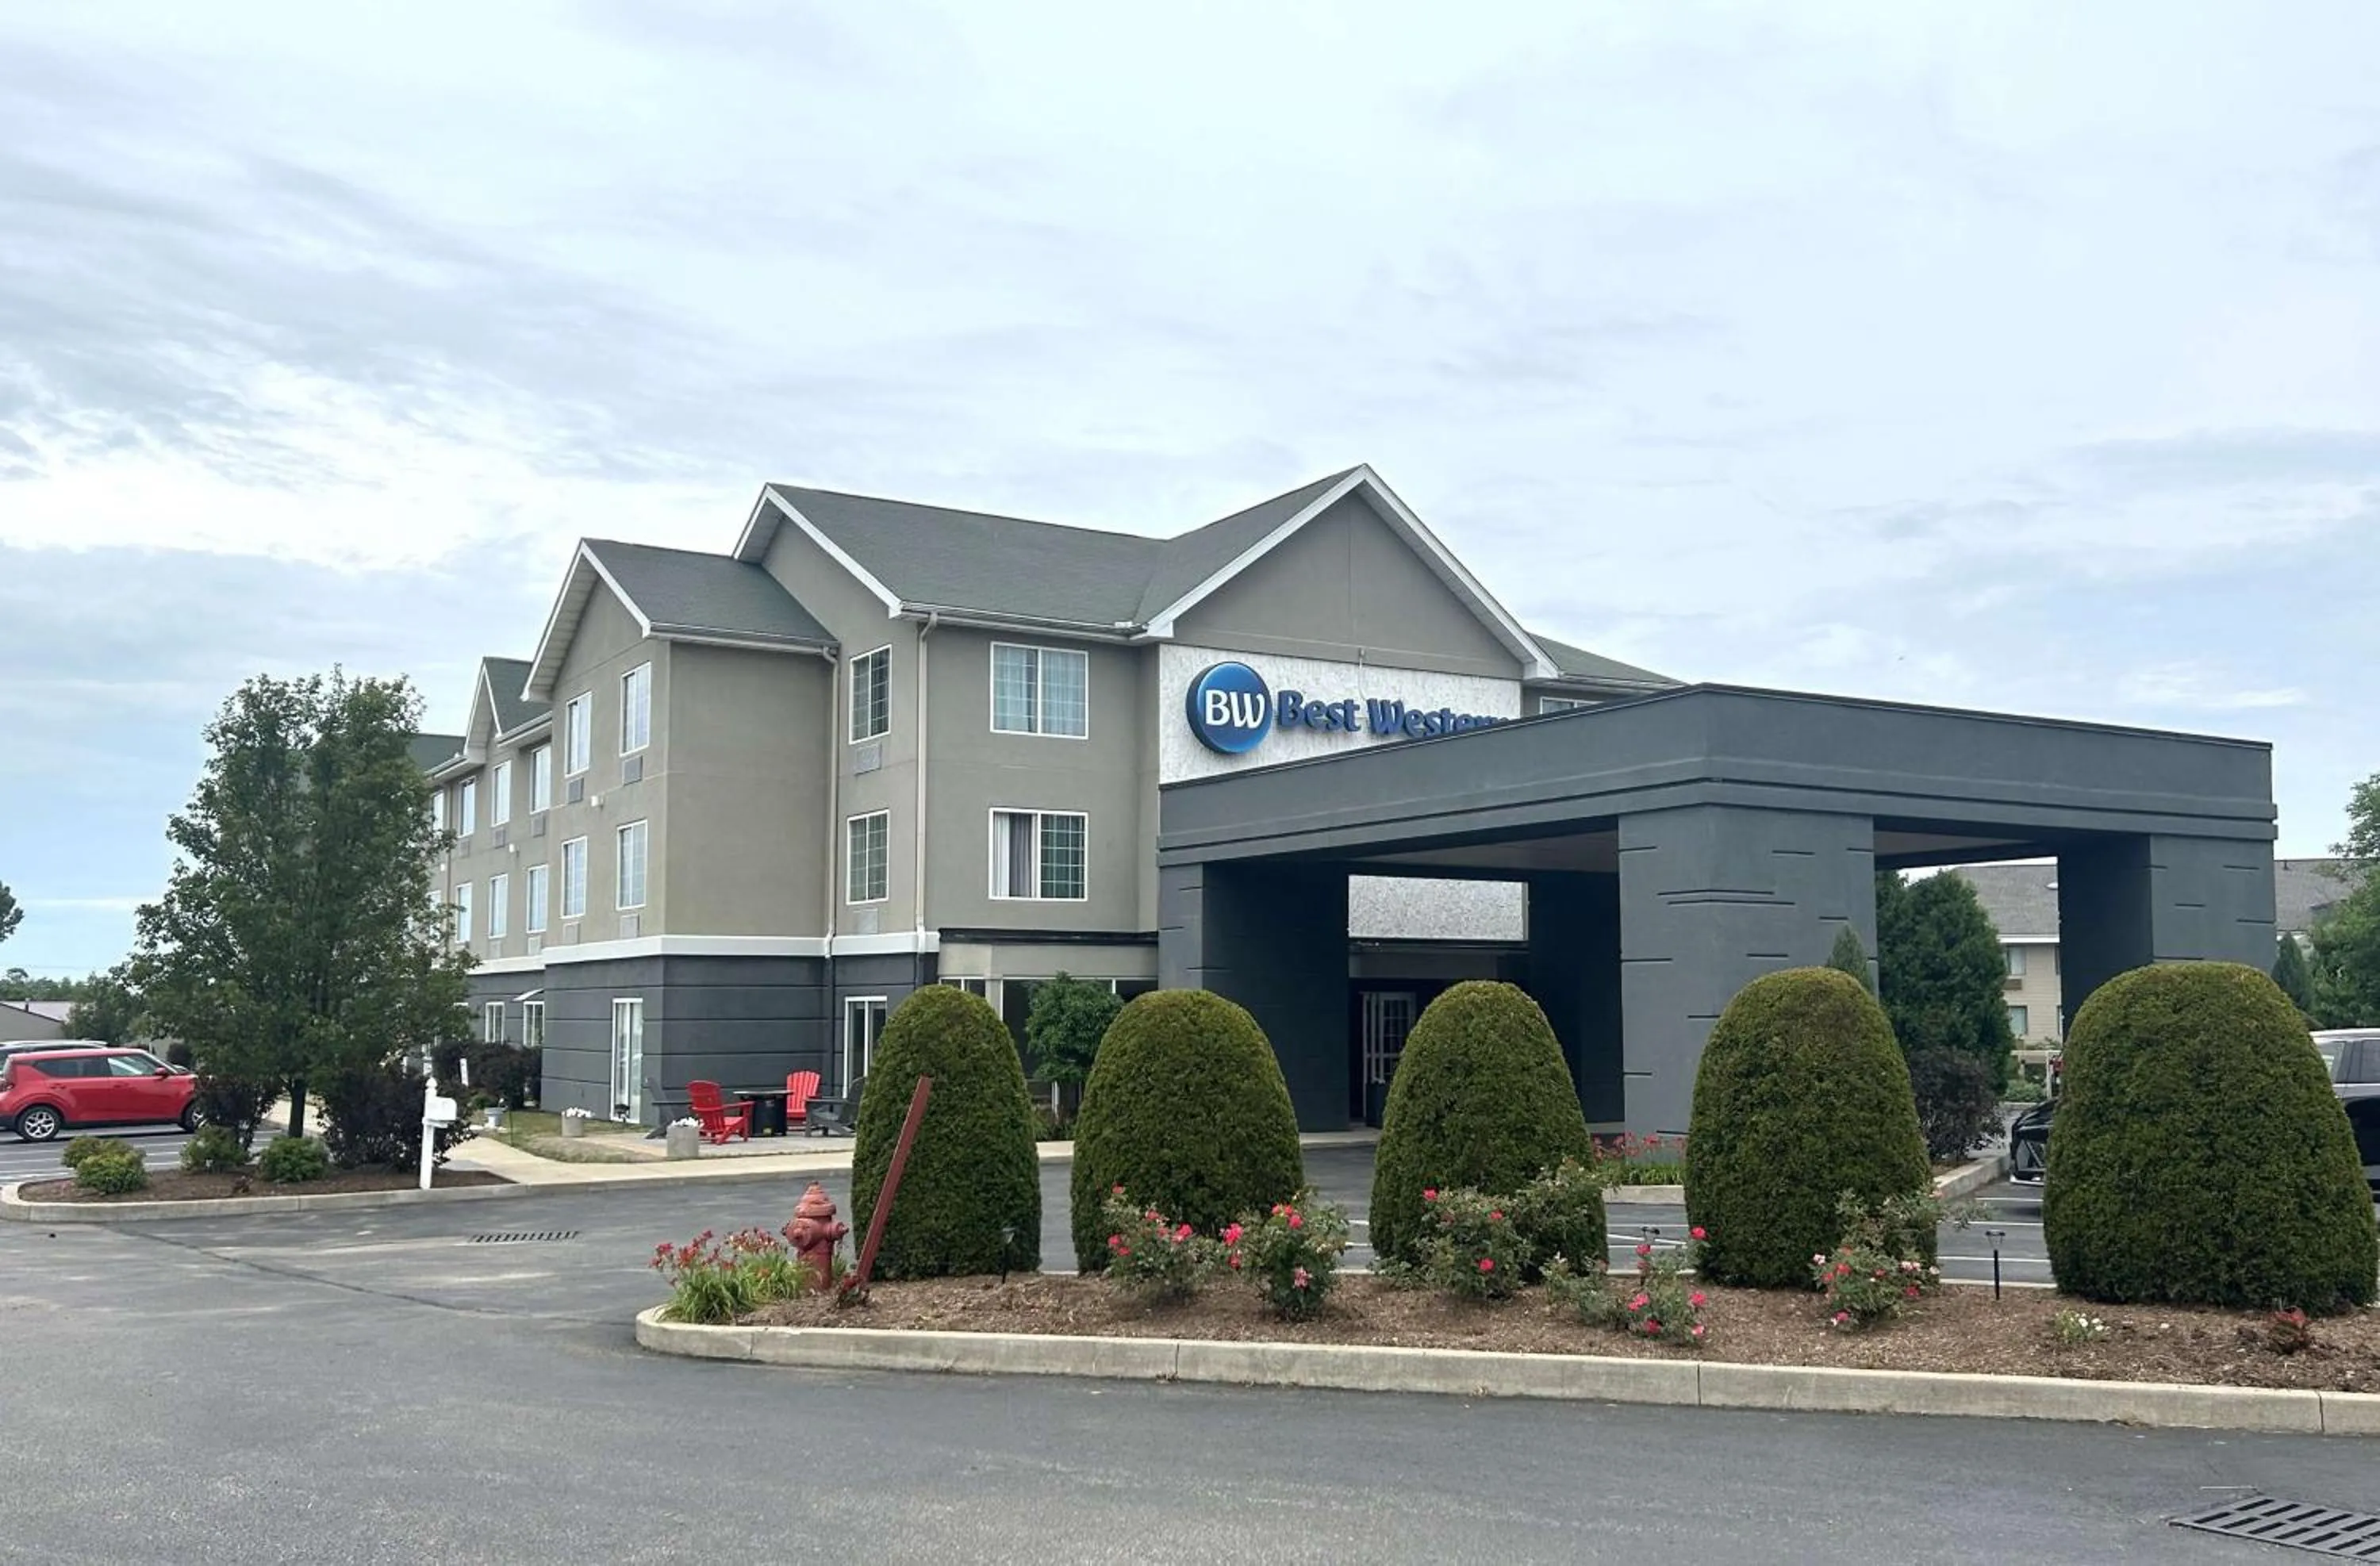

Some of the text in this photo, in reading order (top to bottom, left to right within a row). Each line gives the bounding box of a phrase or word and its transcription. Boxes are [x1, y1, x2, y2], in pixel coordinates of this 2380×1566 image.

[1205, 689, 1265, 729] BW
[1277, 689, 1509, 739] Best Weste
